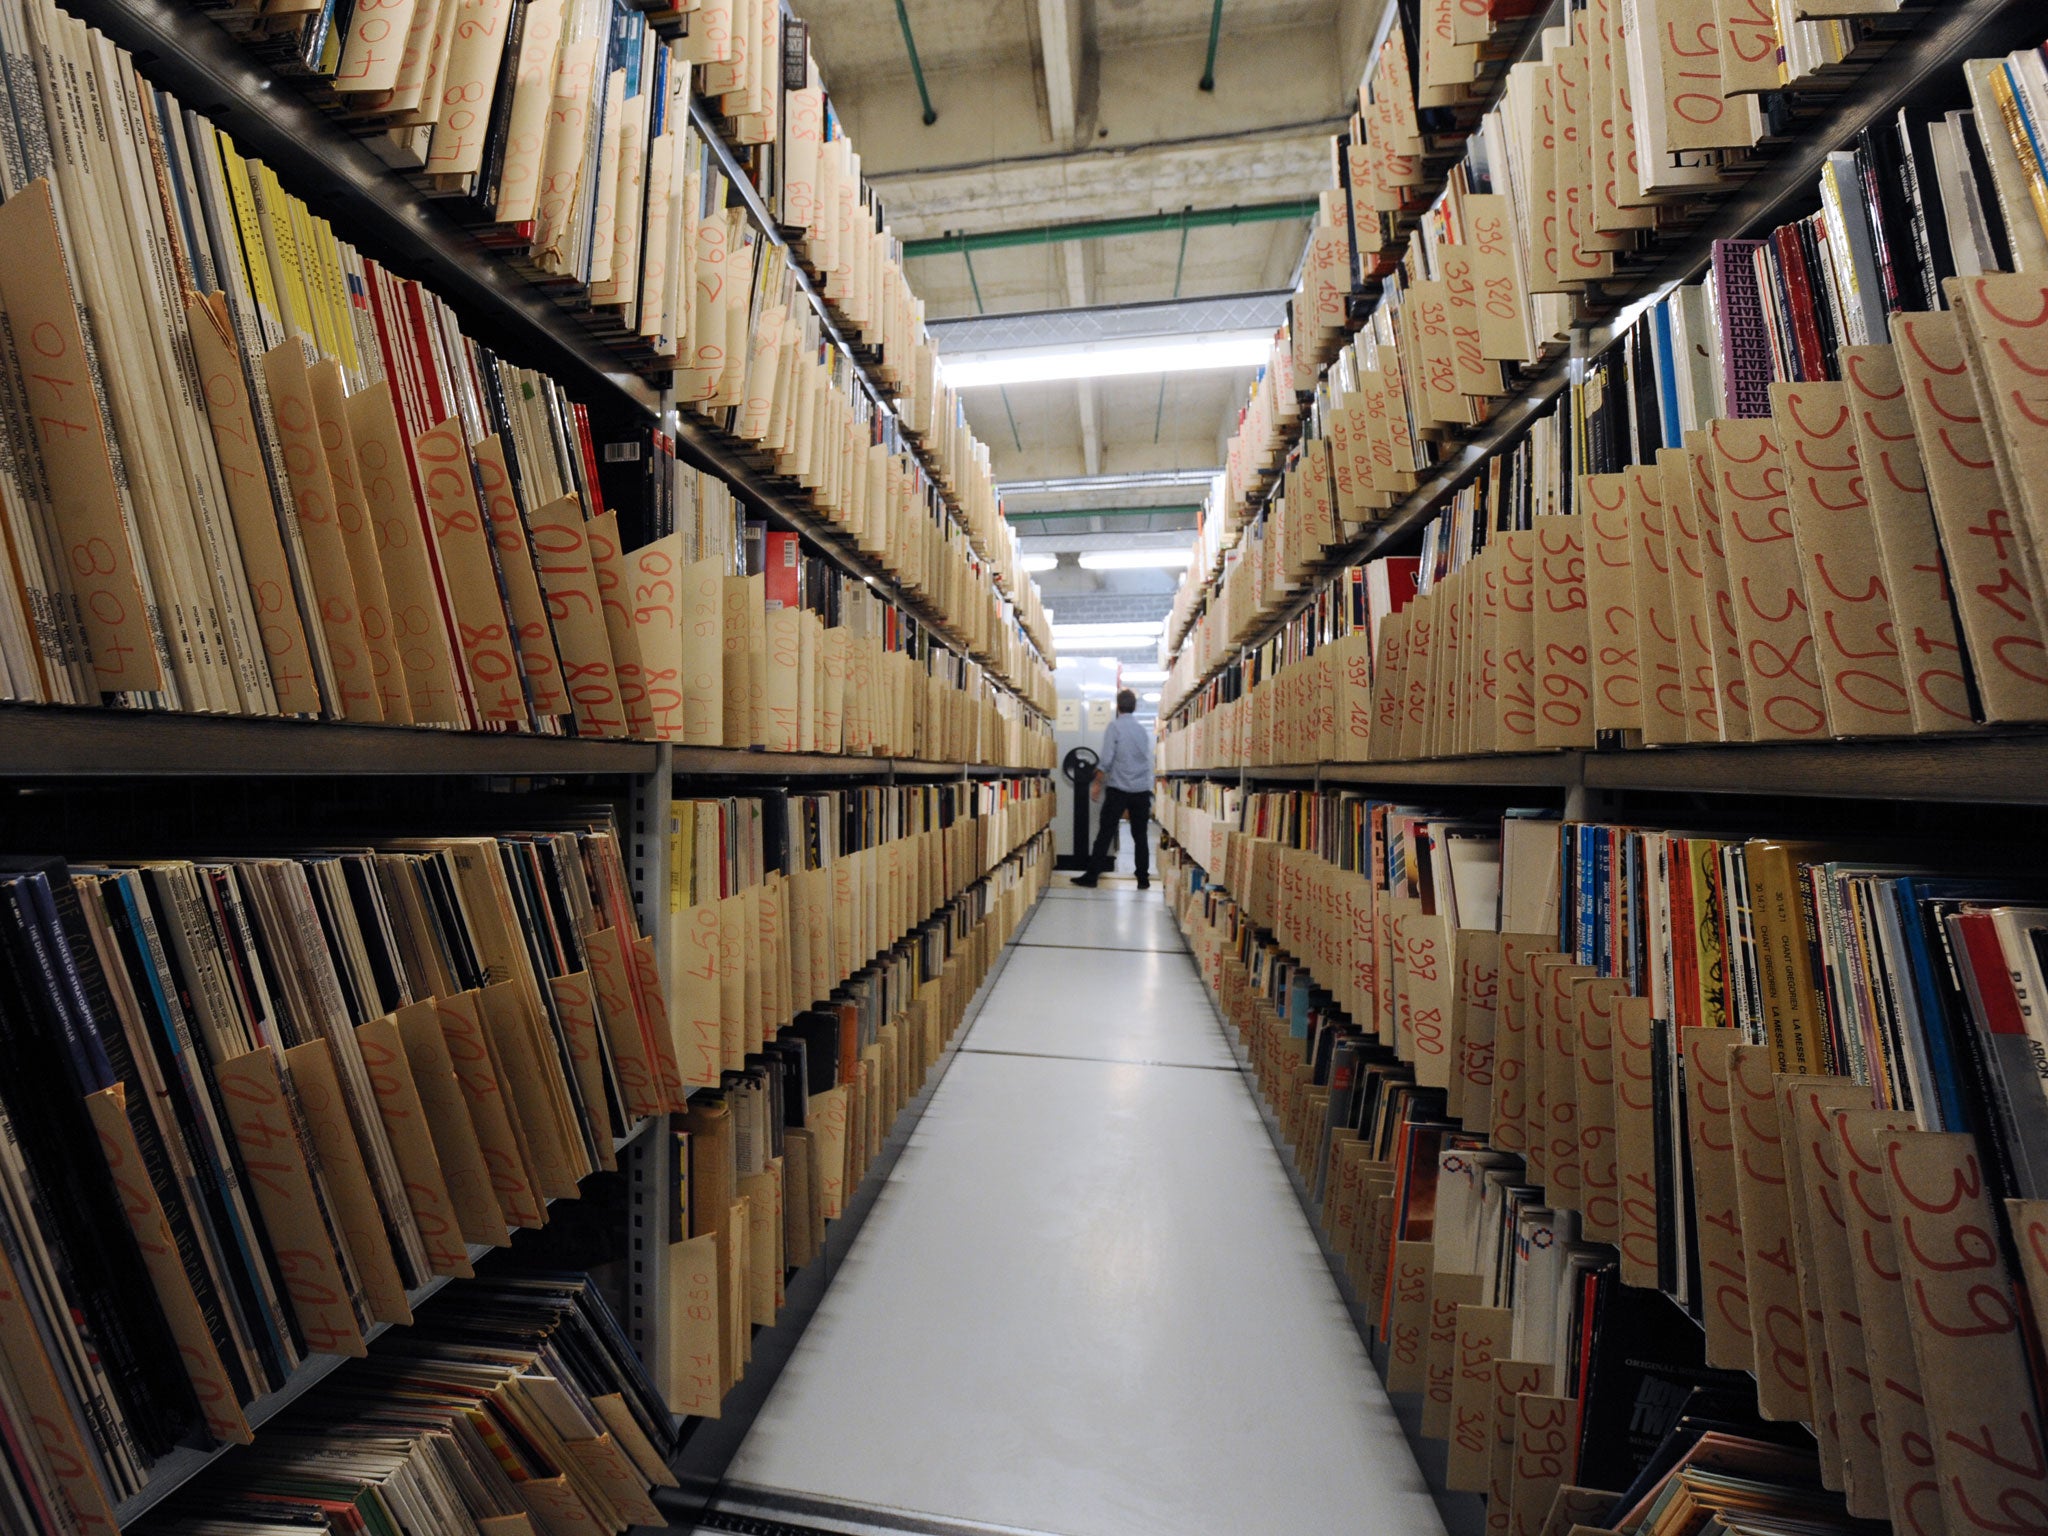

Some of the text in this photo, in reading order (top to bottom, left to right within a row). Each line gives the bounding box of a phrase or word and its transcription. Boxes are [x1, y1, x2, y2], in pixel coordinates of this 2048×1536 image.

[429, 81, 484, 160] 408
[791, 94, 819, 141] 850
[696, 227, 725, 302] 260
[1474, 217, 1516, 319] 396 820
[1726, 275, 1757, 284] LIVE
[1727, 286, 1758, 295] LIVE
[1728, 297, 1760, 306] LIVE
[1421, 301, 1448, 337] 396
[1444, 260, 1486, 375] 396 800
[1729, 307, 1761, 316] LIVE
[1730, 318, 1762, 327] LIVE
[1731, 329, 1764, 338] LIVE
[1732, 339, 1765, 348] LIVE
[1733, 350, 1765, 359] LIVE
[1733, 361, 1766, 370] LIVE
[32, 322, 88, 444] 710
[1734, 371, 1768, 380] LIVE
[1735, 382, 1768, 391] LIVE
[1736, 393, 1769, 402] LIVE
[1737, 403, 1771, 412] LIVE
[72, 536, 135, 675] 408
[634, 550, 675, 629] 930
[693, 578, 718, 638] 920
[1349, 702, 1369, 739] 120
[27, 923, 40, 941] THE
[49, 919, 62, 936] THE
[687, 907, 720, 980] 450
[32, 940, 51, 969] DUKES
[54, 935, 72, 964] DUKES
[1408, 938, 1445, 1056] 397 800
[1759, 924, 1771, 953] CHANT
[1772, 1018, 1784, 1049] MESSE
[1780, 935, 1792, 962] CHANT
[1793, 1032, 1805, 1063] MESSE
[1890, 1141, 2016, 1337] 399
[1455, 1407, 1485, 1453] 320
[1519, 1399, 1568, 1480] 399
